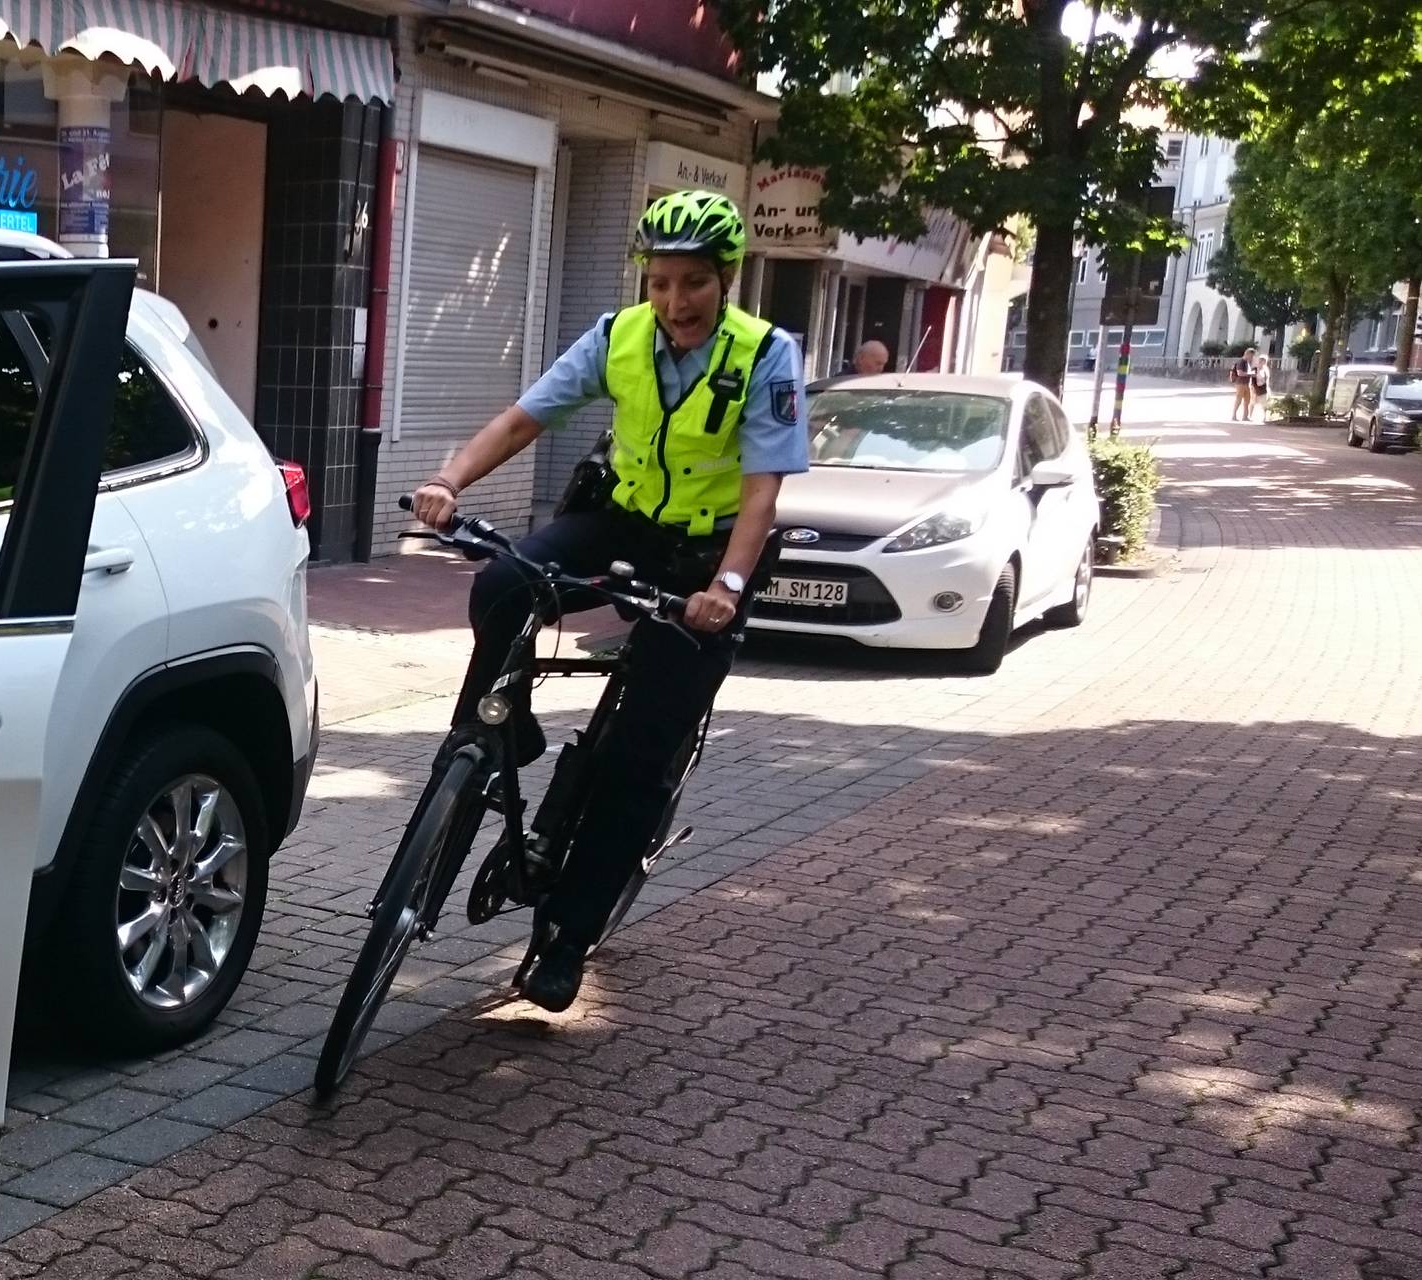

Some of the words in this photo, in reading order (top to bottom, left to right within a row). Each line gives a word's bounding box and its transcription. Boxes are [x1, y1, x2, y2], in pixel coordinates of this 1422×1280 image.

[753, 204, 787, 218] An-
[795, 206, 819, 218] un
[789, 582, 810, 599] SM
[813, 583, 844, 602] 128
